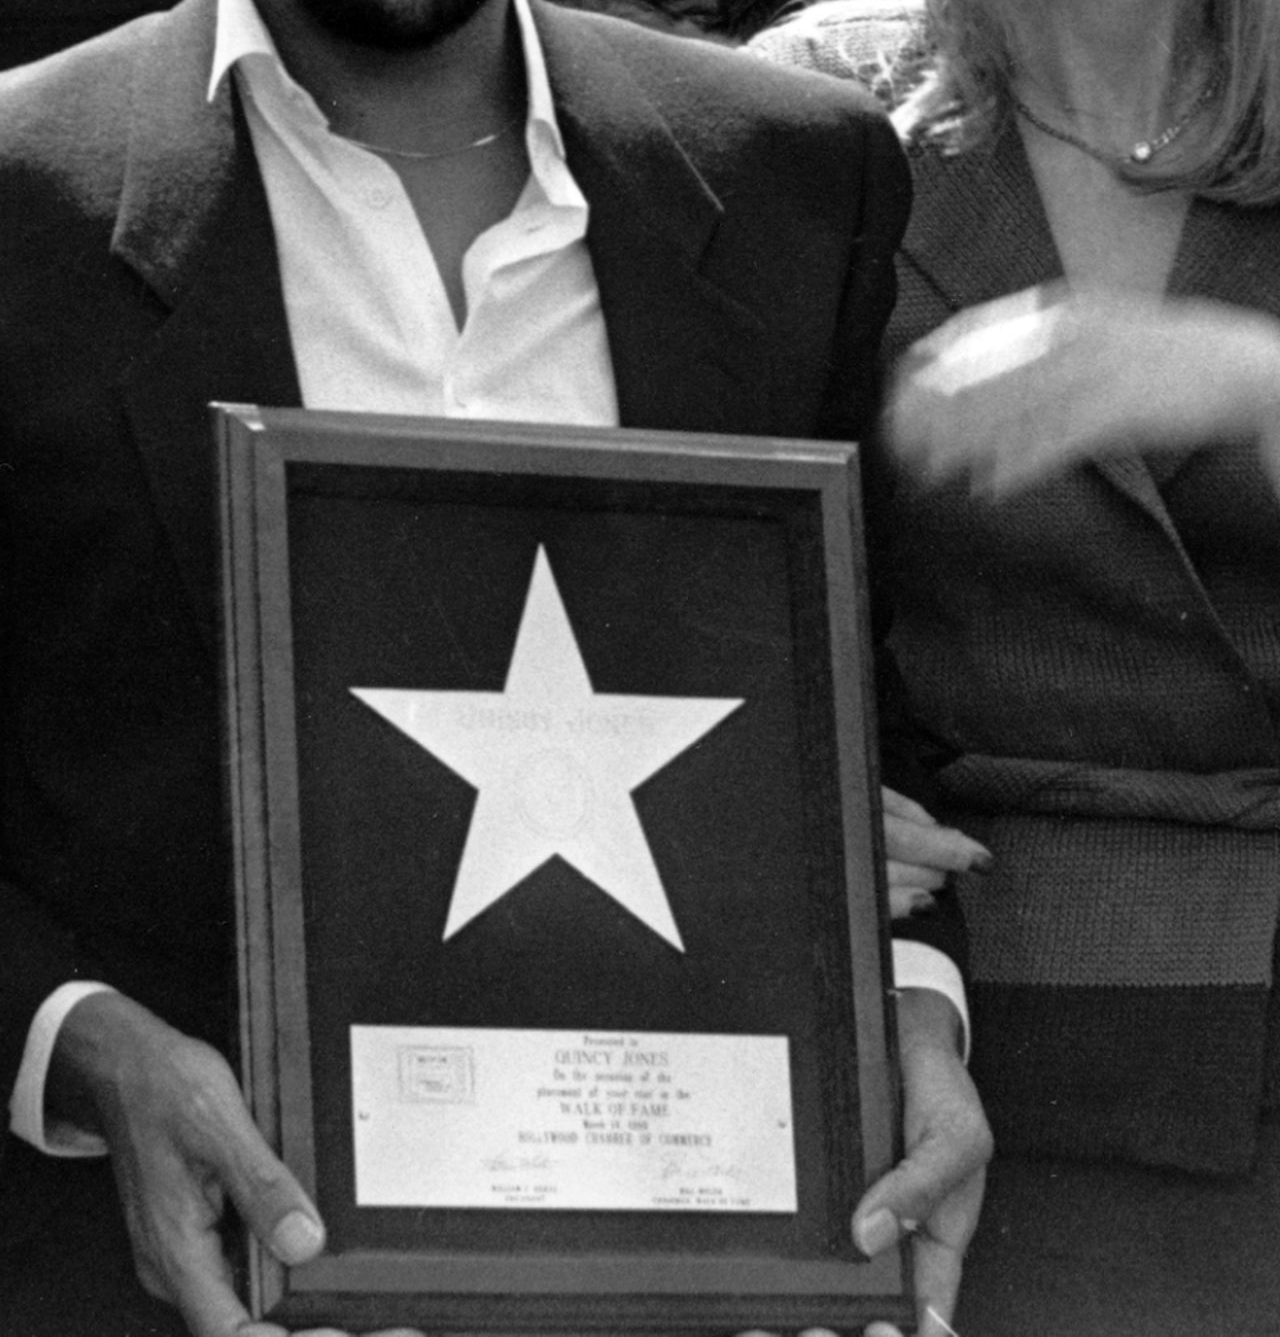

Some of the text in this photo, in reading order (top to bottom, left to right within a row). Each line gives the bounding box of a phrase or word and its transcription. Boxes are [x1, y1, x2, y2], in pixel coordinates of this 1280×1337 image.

[554, 1049, 670, 1067] QUINCY JONES
[559, 1102, 670, 1117] WALK OF FAME
[517, 1130, 712, 1147] HOLLYWOOD CHAMBER OF COMMERCE
